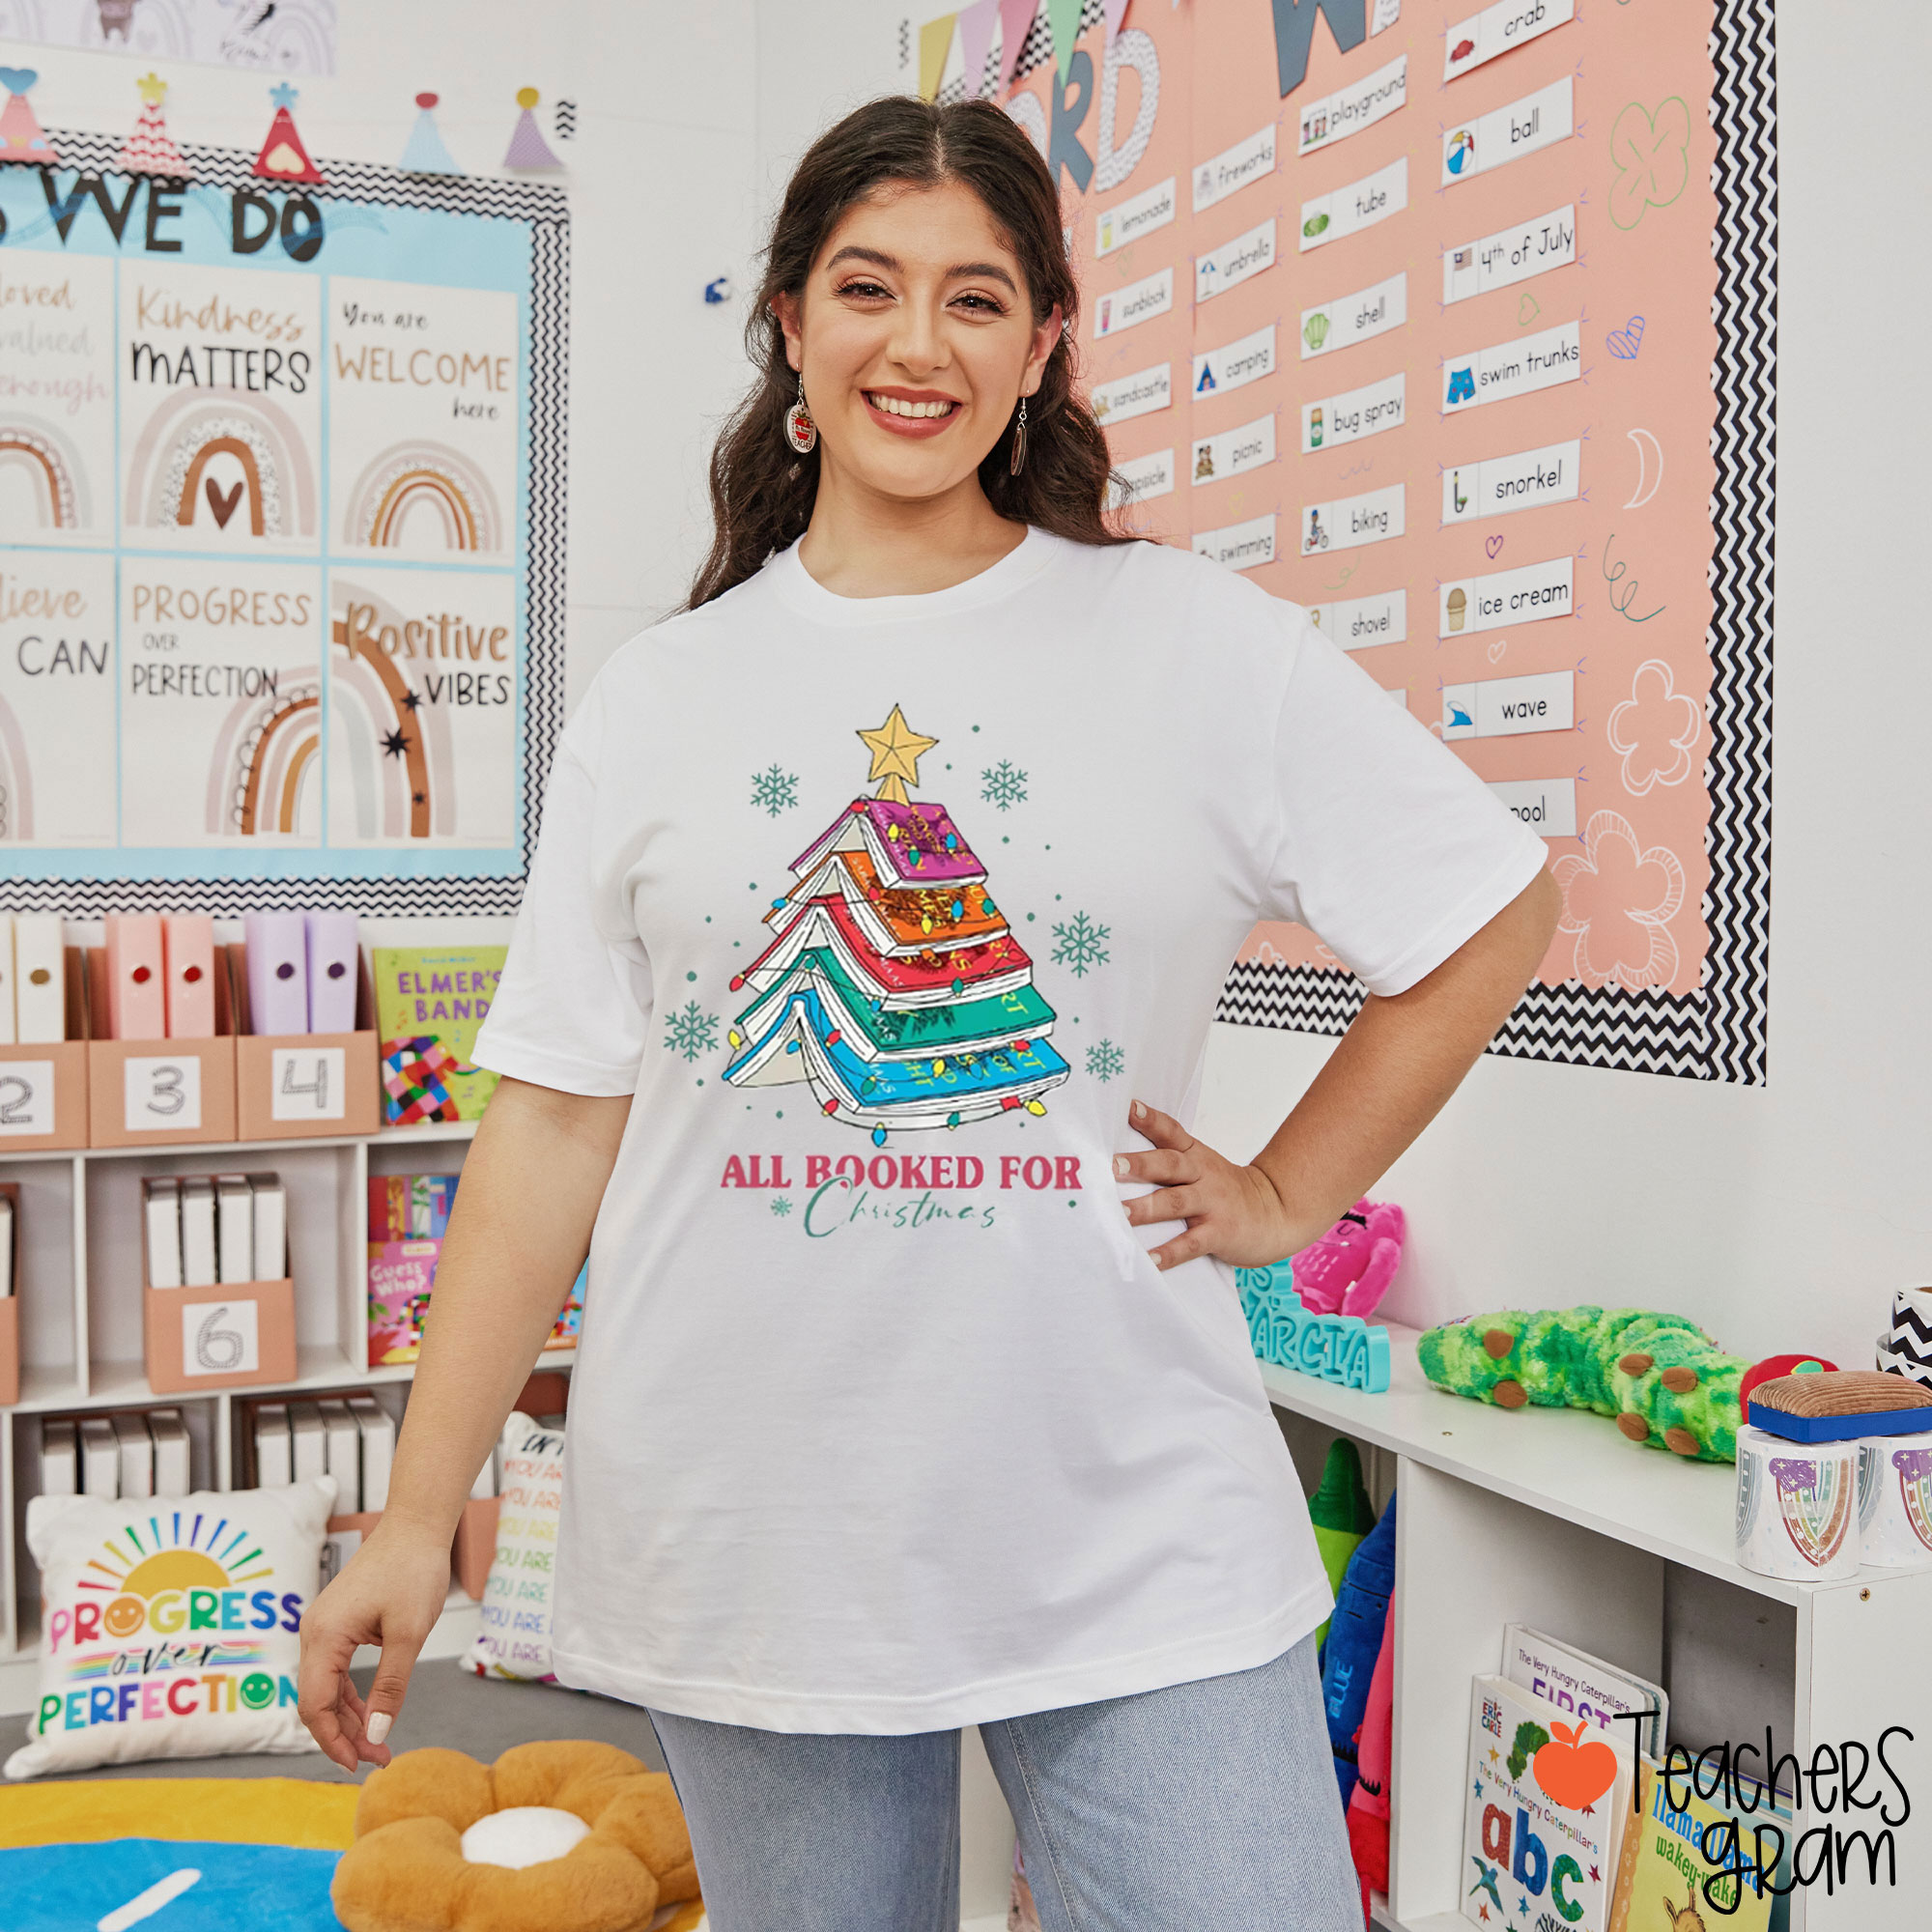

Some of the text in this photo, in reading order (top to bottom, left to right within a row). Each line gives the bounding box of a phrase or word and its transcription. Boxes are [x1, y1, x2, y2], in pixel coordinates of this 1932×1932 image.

[1504, 0, 1546, 36] crab
[1331, 64, 1406, 131] playground
[1511, 106, 1540, 144] ball
[1217, 142, 1273, 187] fireworks
[39, 169, 188, 253] WE
[231, 190, 326, 264] DO
[1121, 192, 1171, 233] lemonade
[1355, 187, 1387, 217] tube
[1224, 238, 1269, 277] umbrella
[1511, 235, 1533, 266] of
[1537, 222, 1574, 255] July
[0, 273, 76, 310] oved
[136, 284, 305, 342] Kindness
[343, 302, 428, 329] You are
[1355, 295, 1385, 328] shell
[335, 343, 511, 392] WELCOME
[1225, 347, 1269, 379] camping
[1480, 340, 1580, 386] swim trunks
[453, 396, 499, 420] here
[1334, 397, 1403, 434] bug spray
[1232, 440, 1263, 469] picnic
[1495, 459, 1562, 498] snorkel
[1351, 507, 1388, 533] biking
[1219, 534, 1272, 563] swimming
[132, 584, 312, 626] PROGRESS
[1479, 583, 1568, 616] ice cream
[145, 632, 180, 650] OVER
[347, 602, 509, 662] Positive
[1351, 606, 1391, 637] shovel
[17, 636, 108, 675] CAN
[131, 663, 279, 697] PERFECTION
[424, 672, 511, 705] VIBES
[1502, 700, 1548, 720] wave
[0, 1075, 34, 1124] 2
[146, 1065, 185, 1115] 3
[280, 1058, 328, 1109] 4
[720, 1154, 1084, 1190] ALL BOOKED FOR
[803, 1176, 996, 1237] Christmas
[369, 1262, 423, 1283] Guess
[196, 1306, 243, 1370] 6
[1247, 1306, 1372, 1388] ARCIA
[50, 1590, 303, 1654] PROGRESS
[111, 1640, 232, 1676] over
[1328, 1661, 1353, 1719] BLUE
[1519, 1647, 1631, 1714] The Very Hungry Caterpillar's
[1481, 1715, 1502, 1739] CARLE
[1482, 1701, 1503, 1725] ERIC
[1479, 1760, 1599, 1855] The Very Hungry Caterpillar's
[1482, 1803, 1584, 1923] abc
